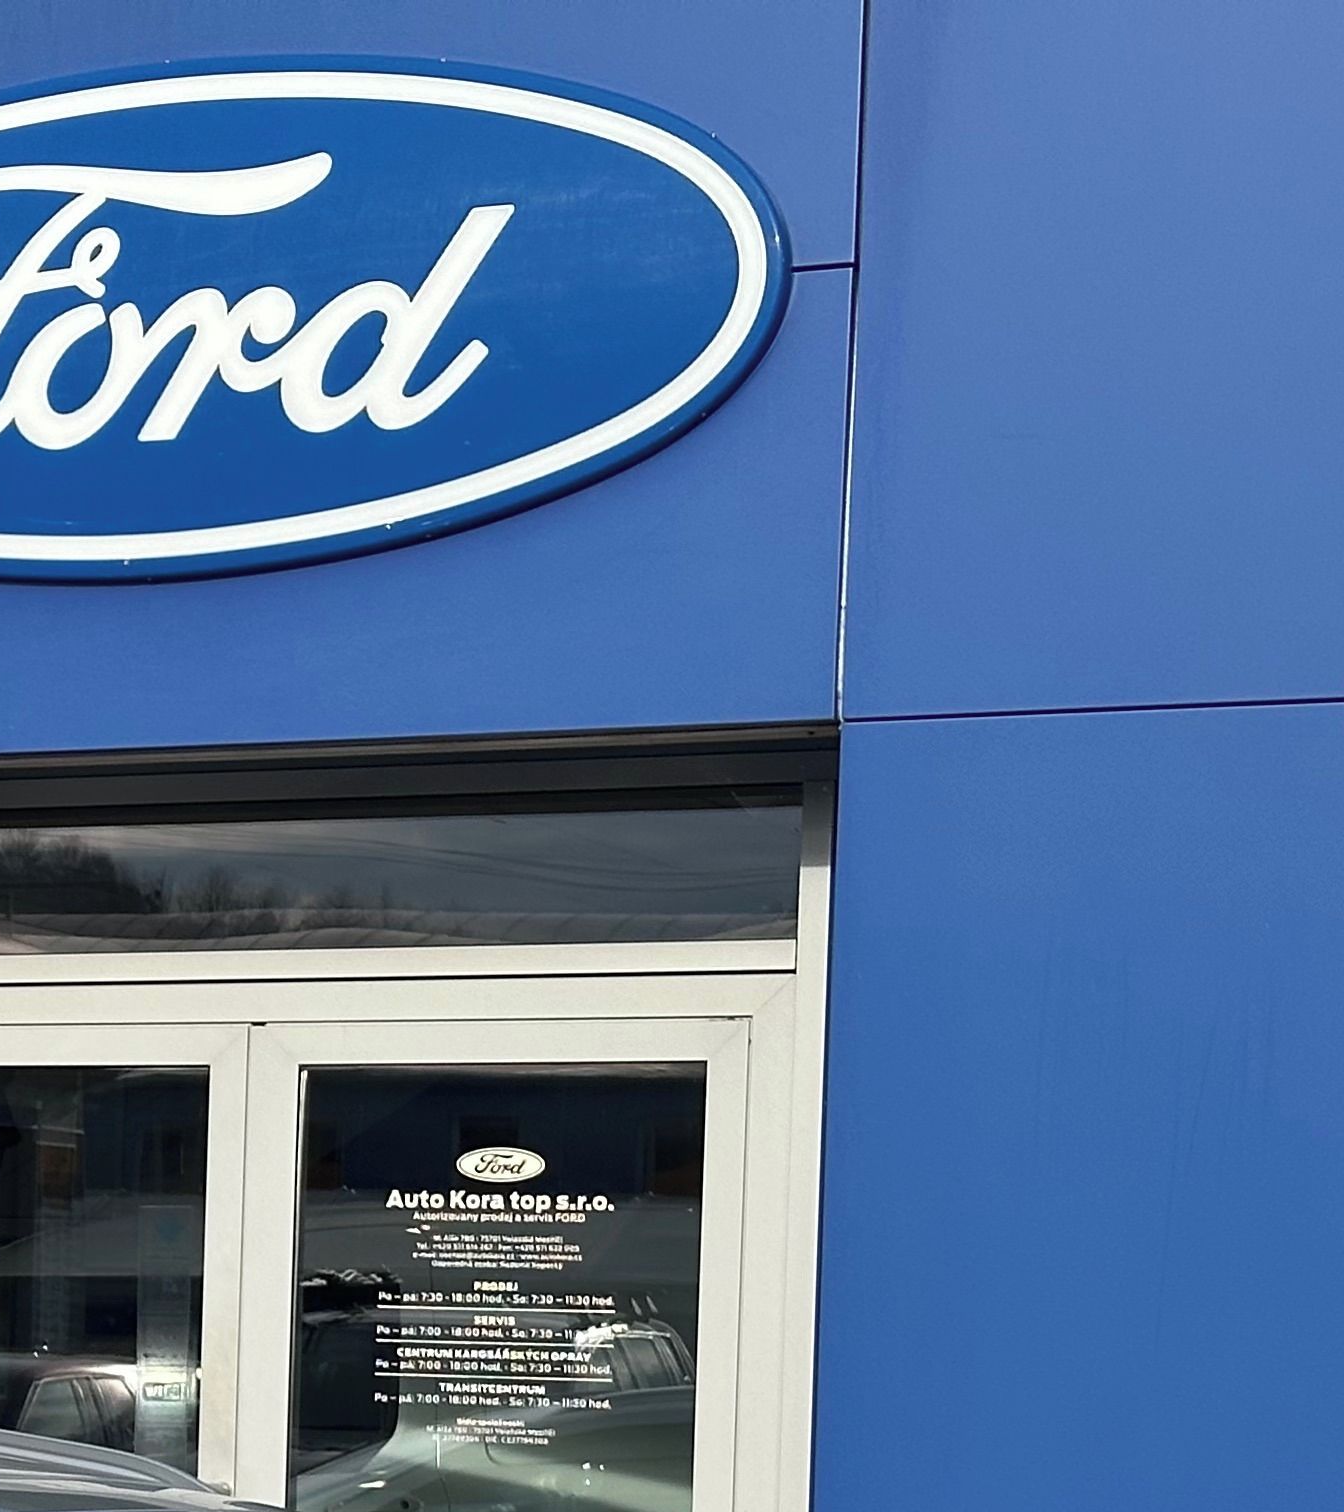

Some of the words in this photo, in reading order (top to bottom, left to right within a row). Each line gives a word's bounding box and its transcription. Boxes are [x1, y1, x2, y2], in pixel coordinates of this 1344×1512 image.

[474, 1154, 526, 1175] Ford
[386, 1189, 445, 1209] Auto
[450, 1190, 505, 1210] Kora
[510, 1191, 551, 1213] top
[556, 1194, 615, 1211] s.r.o.
[555, 1213, 586, 1223] FORD
[473, 1315, 516, 1326] SERVIS
[397, 1347, 453, 1358] CENTRUM
